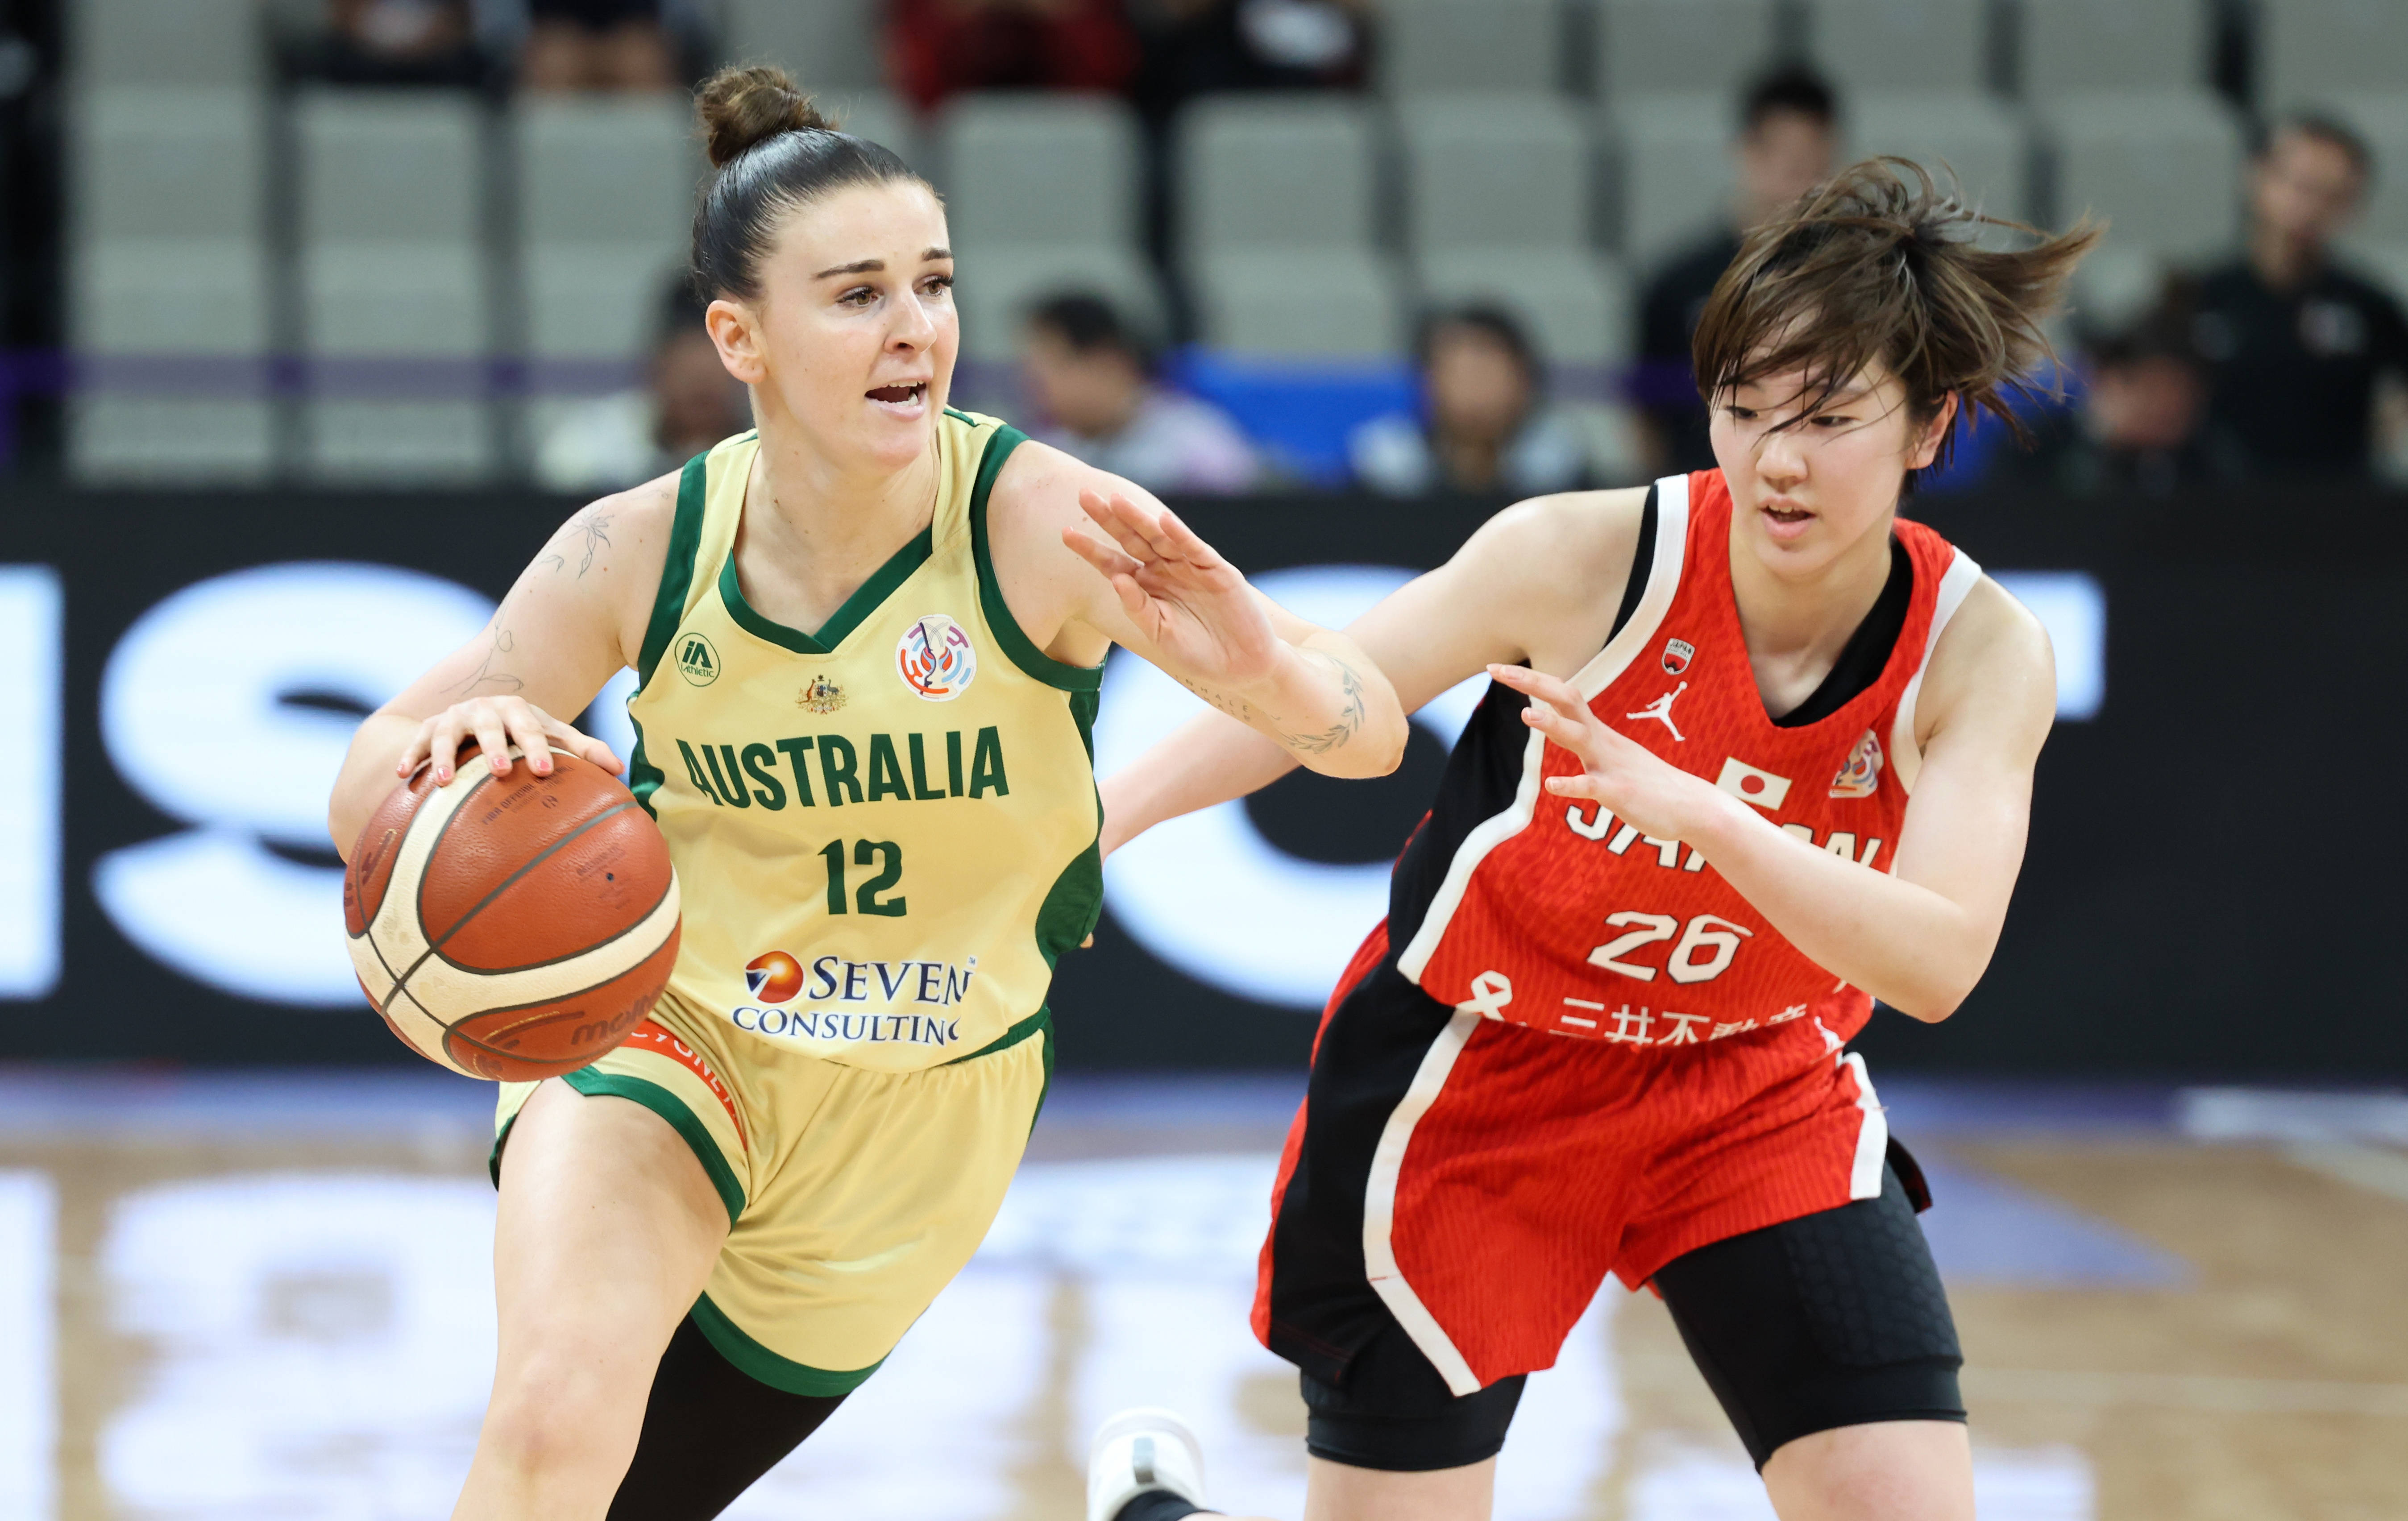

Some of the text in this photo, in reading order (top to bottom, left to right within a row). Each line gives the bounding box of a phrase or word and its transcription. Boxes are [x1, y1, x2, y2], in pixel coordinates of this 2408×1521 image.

[675, 725, 1009, 812] AUSTRALIA
[817, 839, 907, 917] 12
[809, 956, 973, 1006] SEVEN
[1586, 910, 1755, 983] 26
